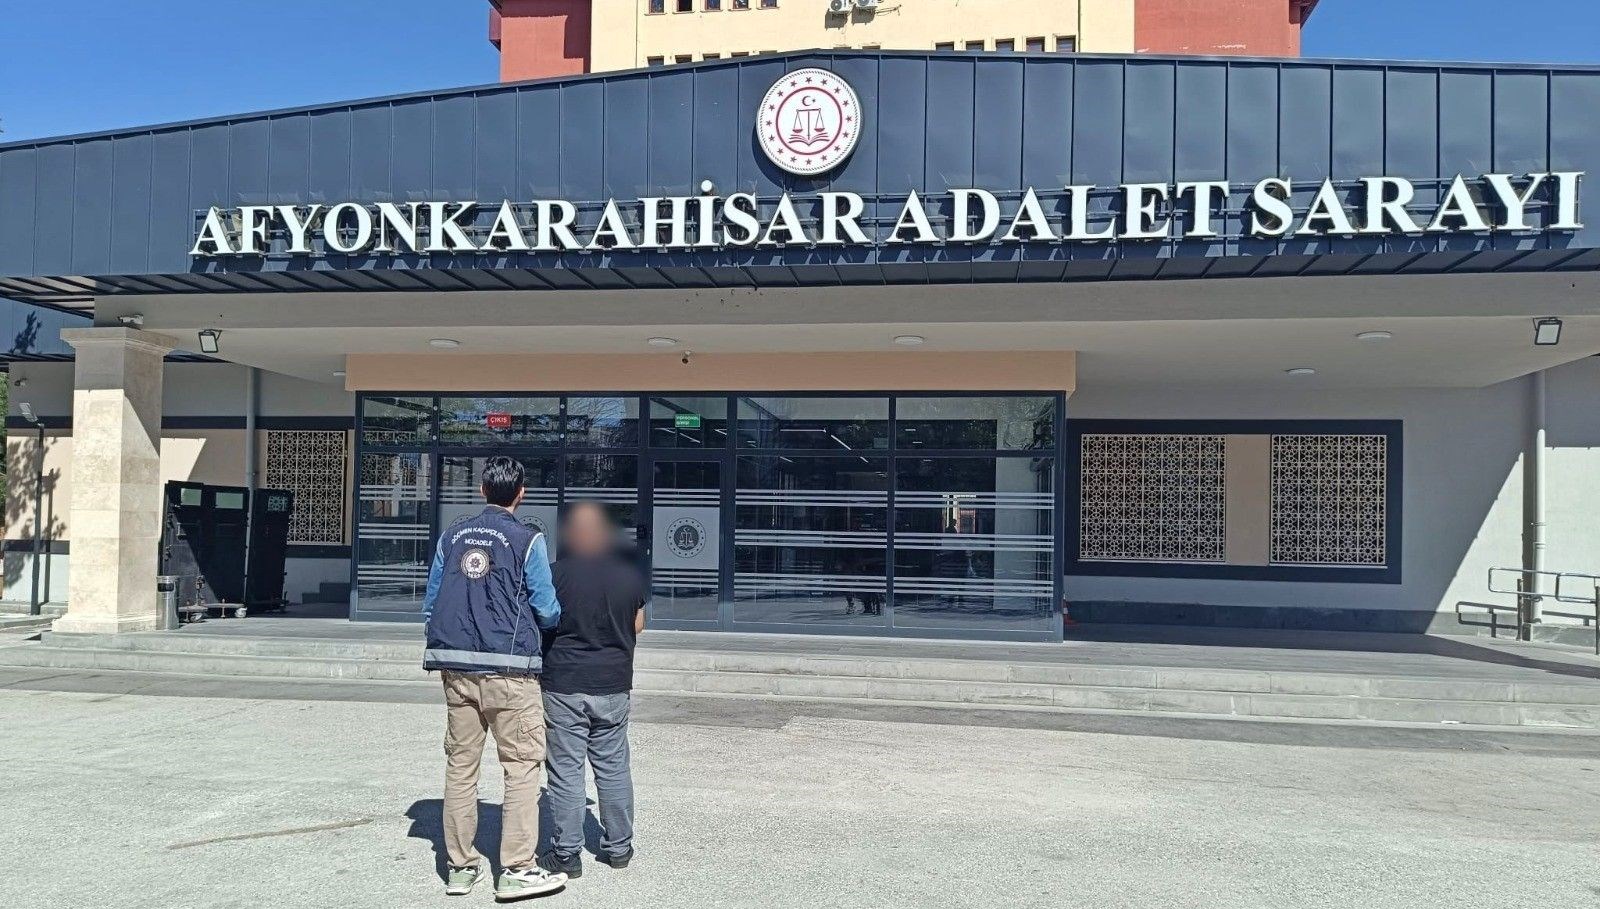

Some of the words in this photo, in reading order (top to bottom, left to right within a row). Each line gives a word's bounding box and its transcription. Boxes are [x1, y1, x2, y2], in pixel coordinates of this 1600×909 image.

[189, 180, 871, 255] AFYONKARAHİSAR
[885, 181, 1230, 243] ADALET
[1250, 171, 1584, 236] SARAYI
